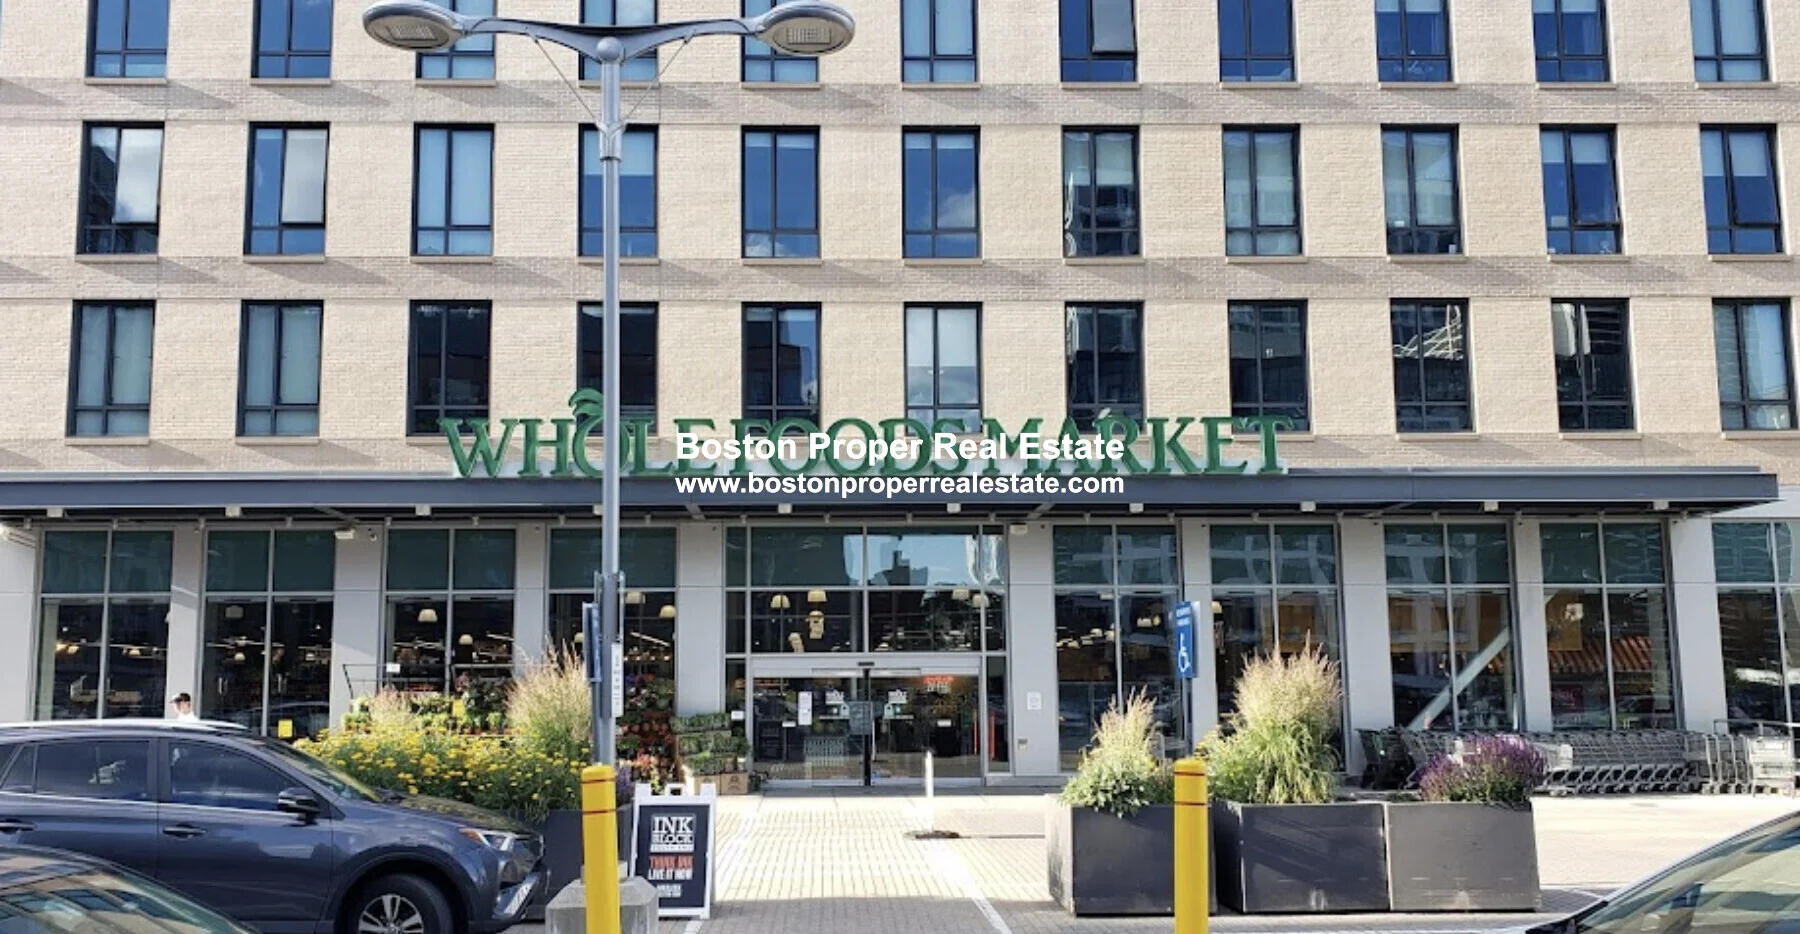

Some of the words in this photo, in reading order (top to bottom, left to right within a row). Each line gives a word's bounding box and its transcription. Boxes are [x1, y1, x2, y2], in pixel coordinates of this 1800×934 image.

[439, 417, 717, 477] WHOLE
[729, 417, 970, 477] FOODS
[980, 416, 1295, 475] MARKET
[652, 816, 693, 834] INK
